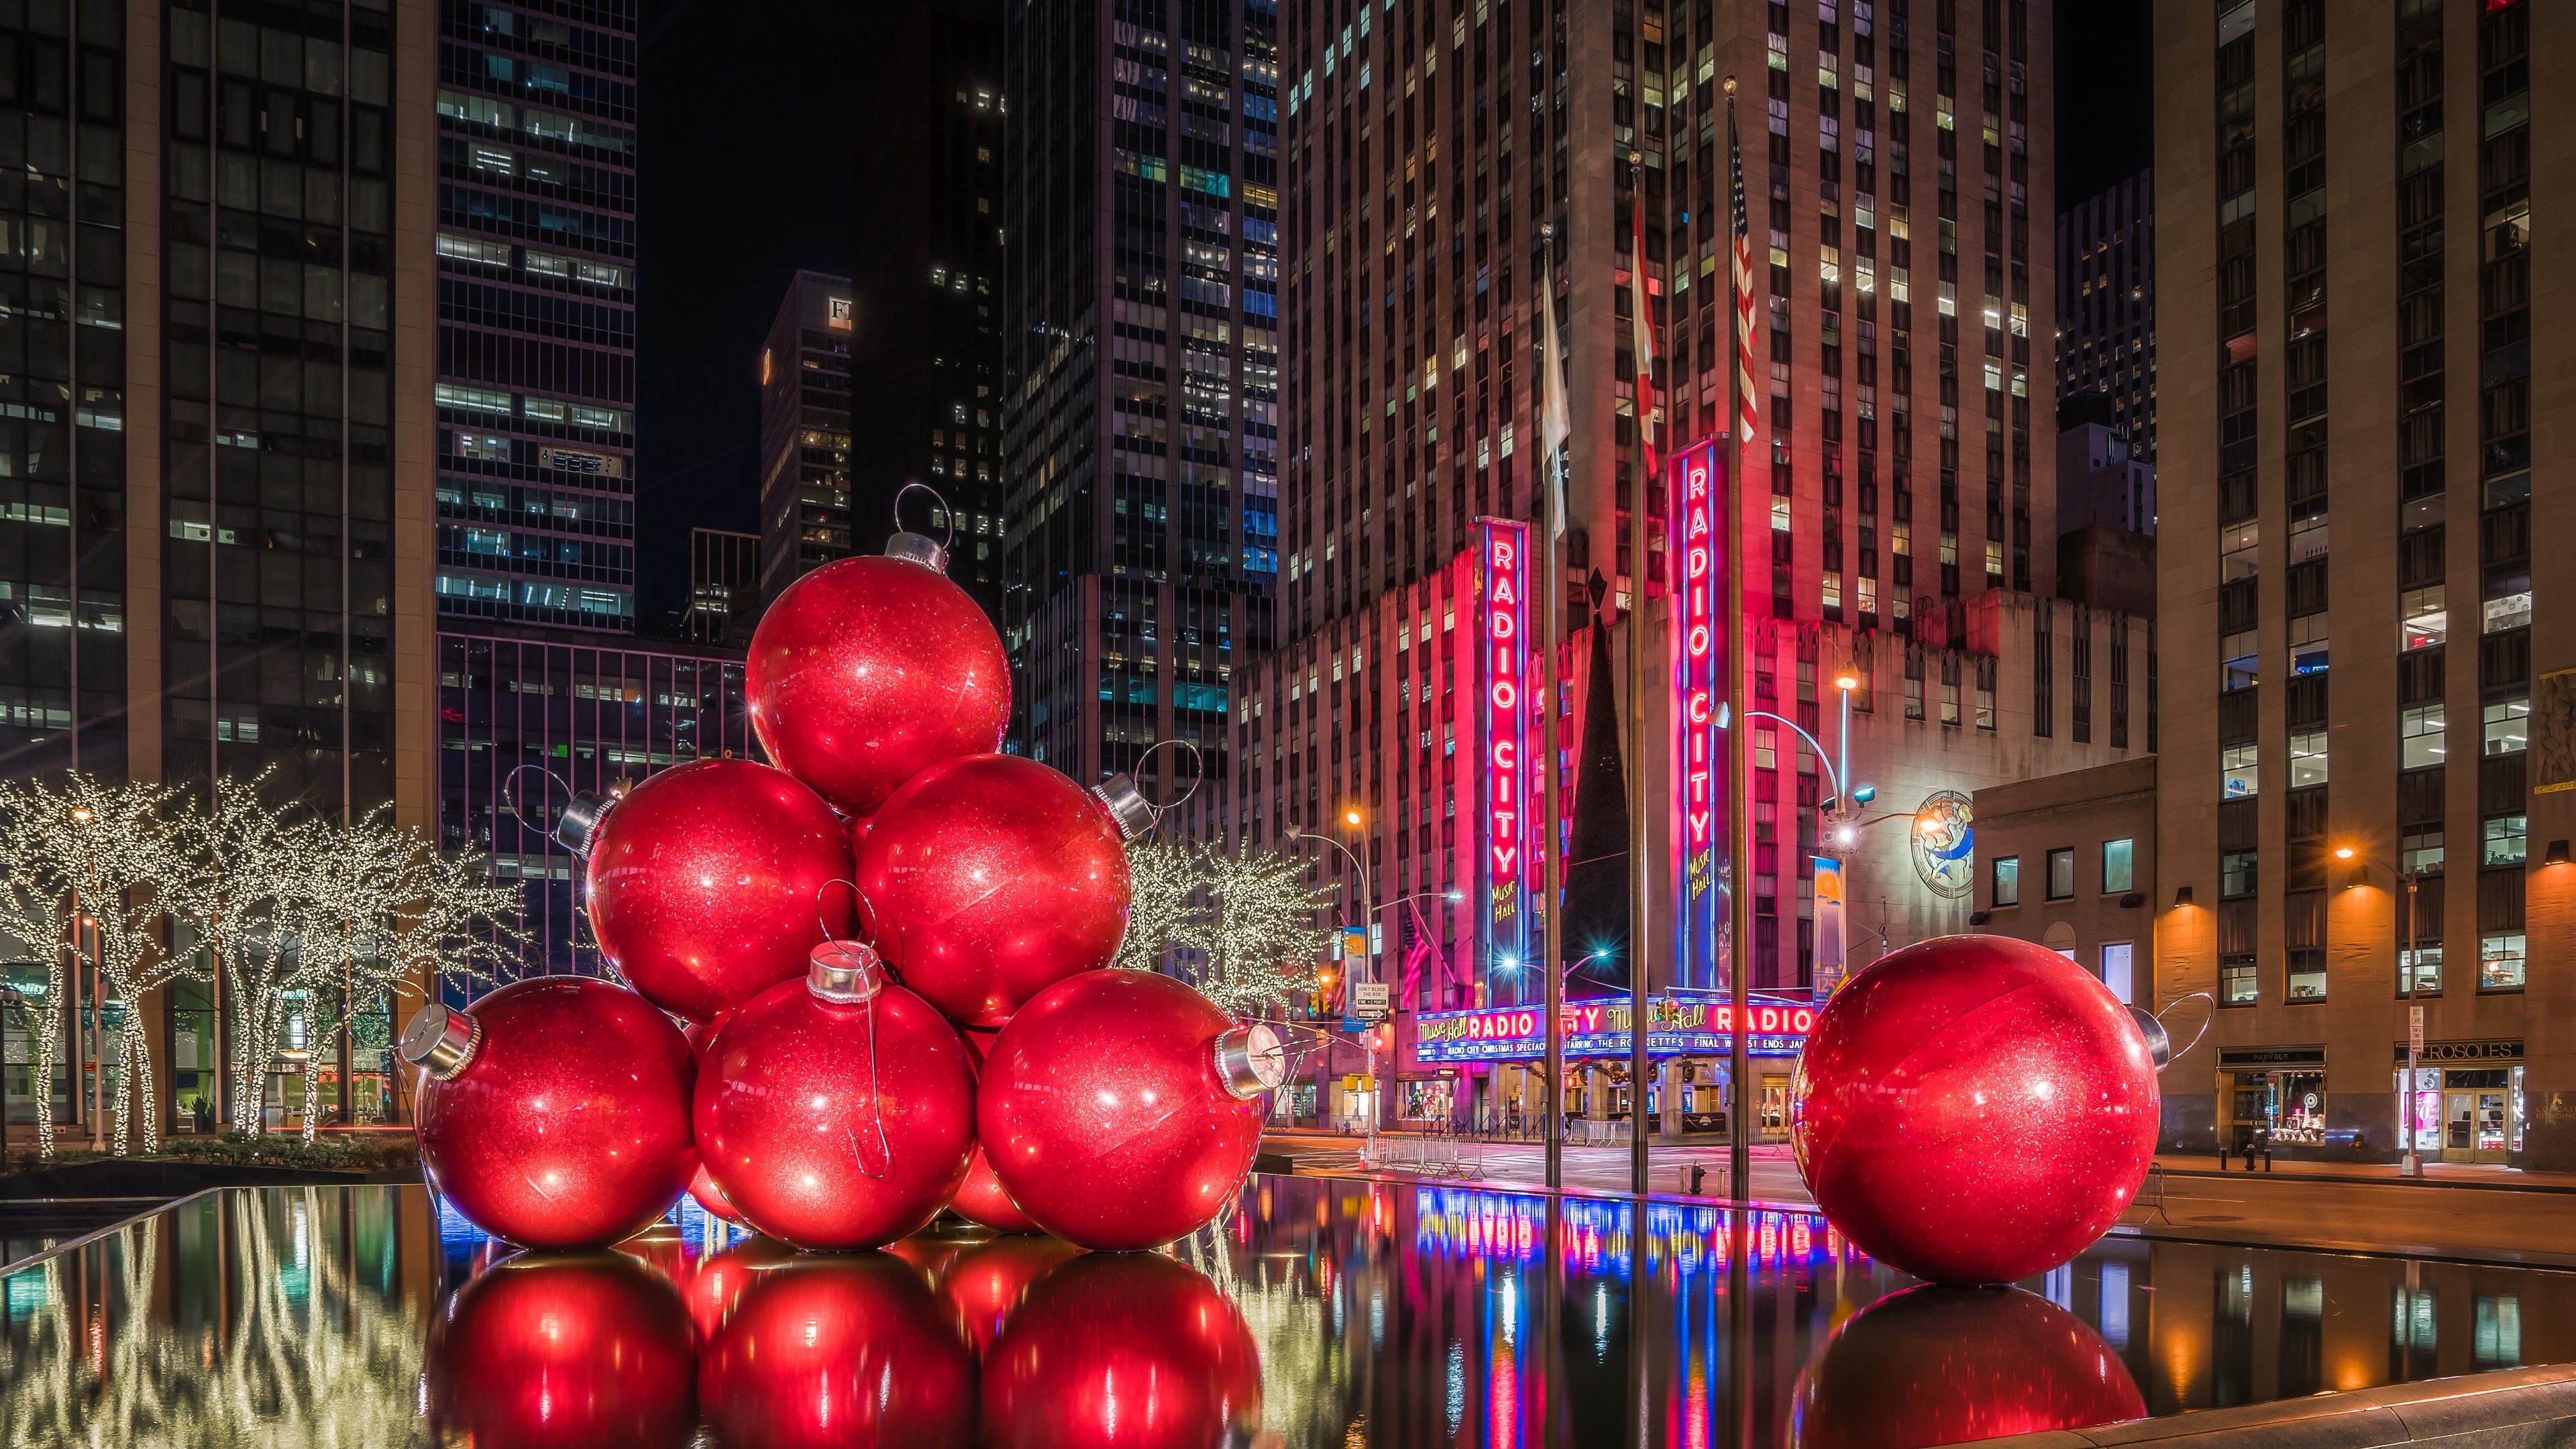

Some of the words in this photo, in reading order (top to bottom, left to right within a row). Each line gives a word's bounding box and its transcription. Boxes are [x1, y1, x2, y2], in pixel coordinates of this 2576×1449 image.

[1688, 468, 1709, 655] RADIO
[1493, 541, 1515, 708] RADIO
[1689, 693, 1709, 843] CITY
[1493, 741, 1515, 873] CITY
[1689, 848, 1710, 877] MUSIC
[1492, 881, 1515, 905] MUSIC
[1693, 872, 1711, 900] HALL
[1495, 901, 1515, 924] HALL
[1419, 1022, 1446, 1042] Music
[1444, 1016, 1468, 1042] Hall
[1469, 1013, 1532, 1039] RADIO
[1448, 1047, 1464, 1055] RADIO
[1466, 1046, 1479, 1054] CITY
[1482, 1044, 1513, 1054] CHRISTMAS
[1597, 1039, 1613, 1048] THE
[1695, 1038, 1719, 1048] FINAL
[1763, 1040, 1784, 1049] ENDS
